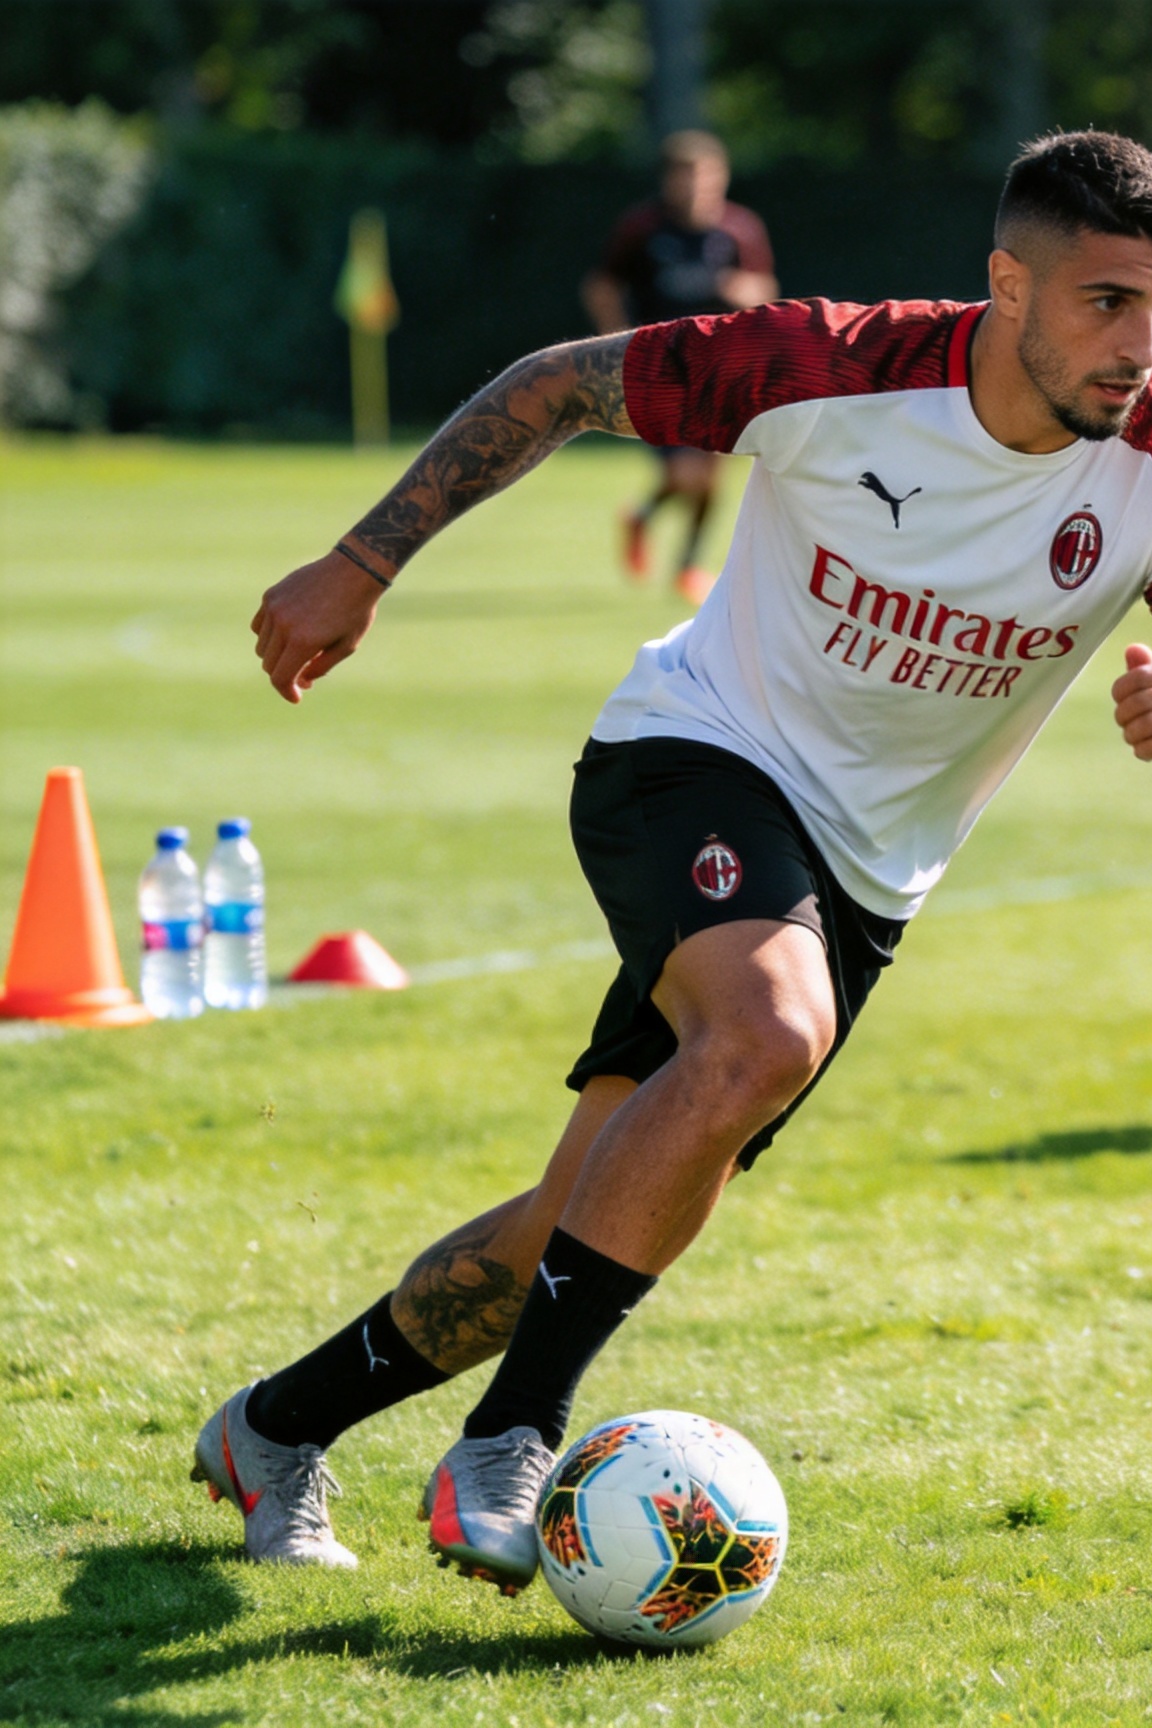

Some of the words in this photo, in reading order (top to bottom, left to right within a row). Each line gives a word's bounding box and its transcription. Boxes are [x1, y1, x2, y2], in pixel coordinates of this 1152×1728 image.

[809, 543, 1079, 660] Emirates
[823, 621, 888, 672] FLY
[890, 647, 1022, 698] BETTER
